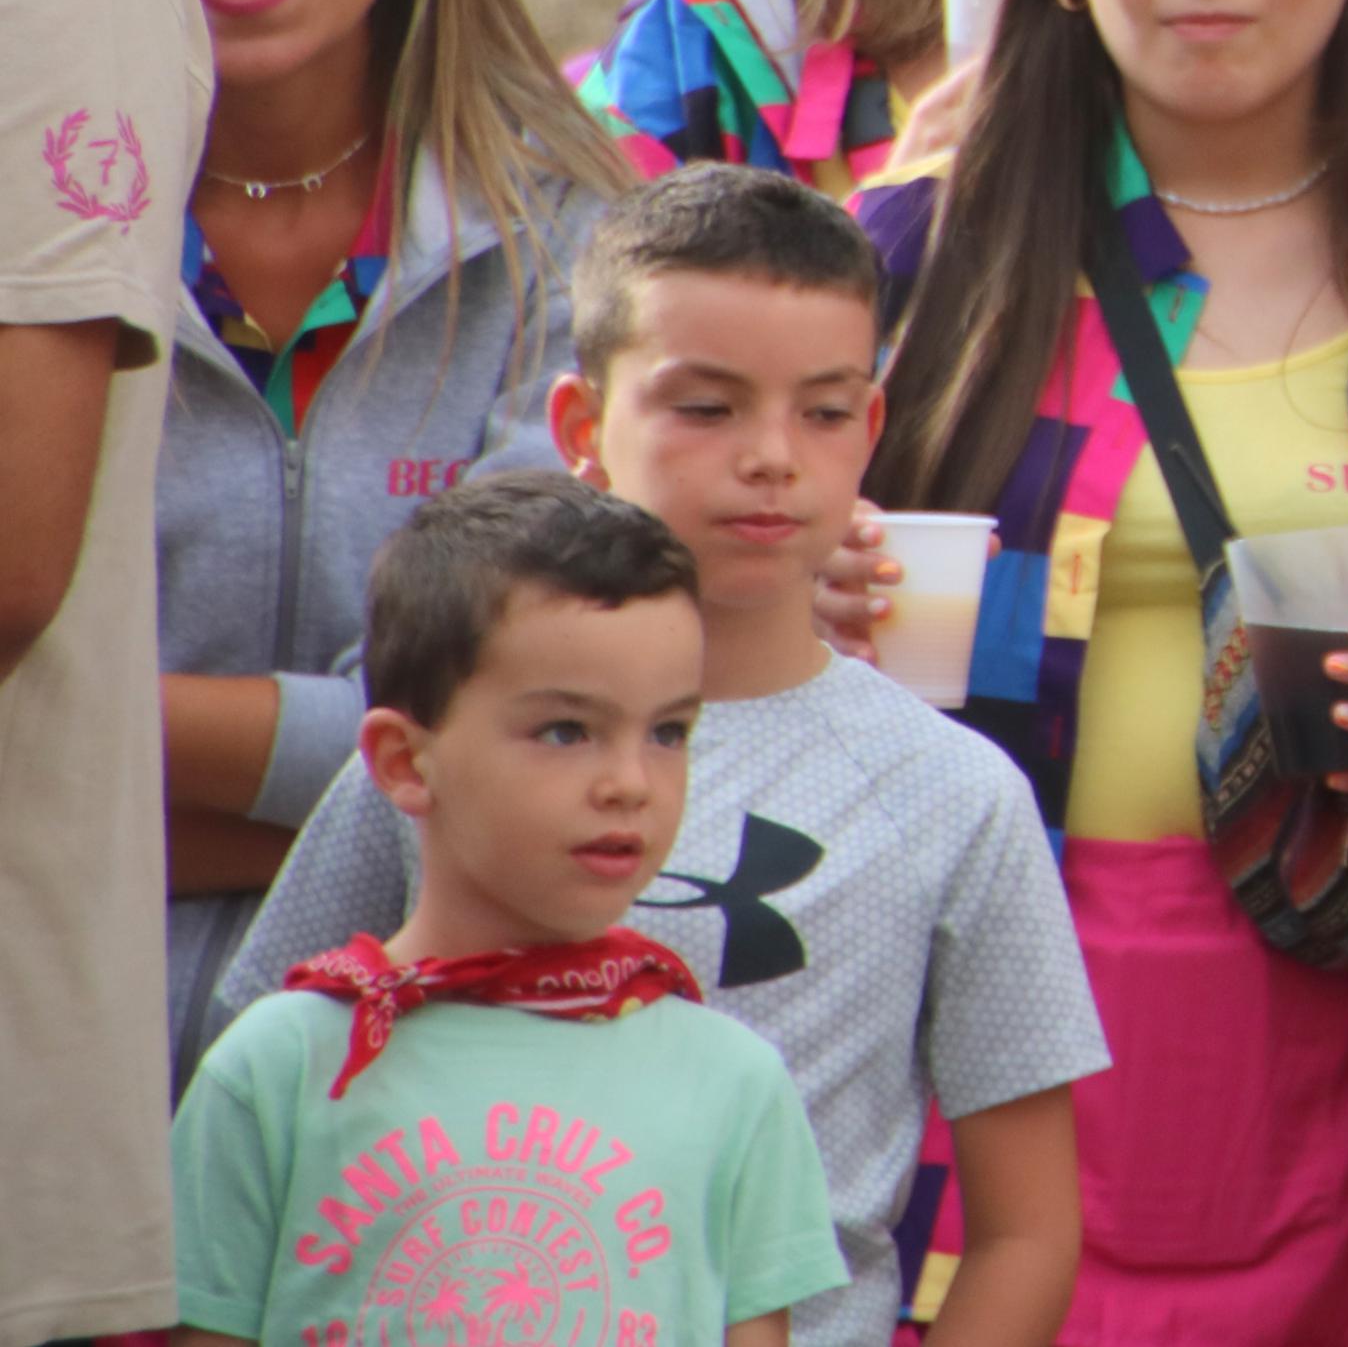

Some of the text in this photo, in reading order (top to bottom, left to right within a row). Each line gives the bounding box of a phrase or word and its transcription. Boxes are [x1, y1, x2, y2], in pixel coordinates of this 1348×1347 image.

[295, 1102, 672, 1280] SANTA CRUZ CO.
[376, 1196, 600, 1307] SURF CONTEST
